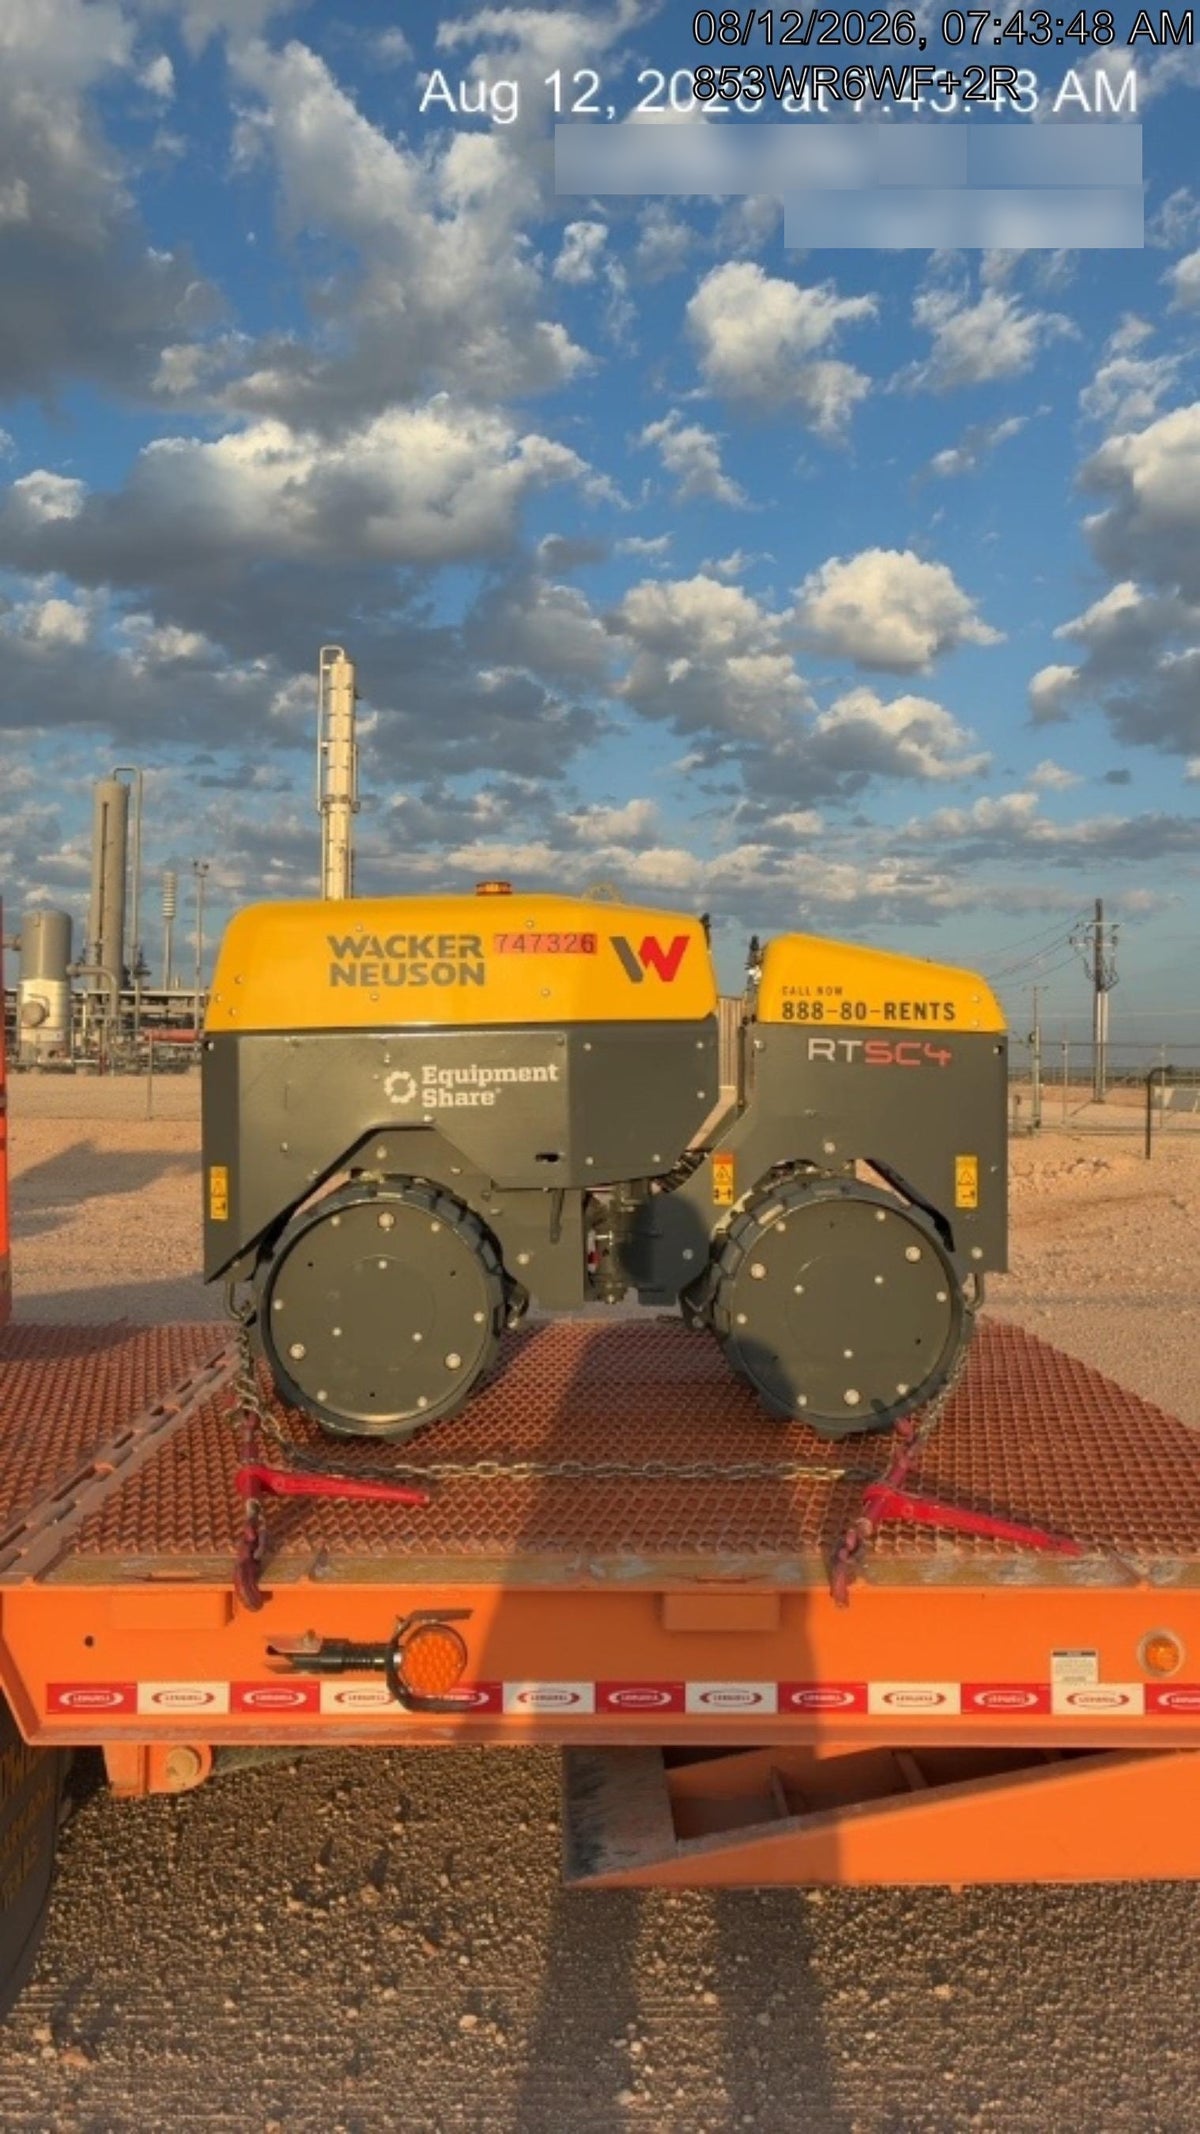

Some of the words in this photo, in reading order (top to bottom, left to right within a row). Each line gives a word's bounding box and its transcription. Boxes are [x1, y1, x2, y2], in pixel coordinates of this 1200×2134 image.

[326, 934, 486, 959] WACKER
[496, 933, 597, 954] 747326
[329, 962, 486, 987] NEUSON
[781, 1001, 956, 1021] 888-80-RENTS
[807, 1038, 952, 1067] RTSC4
[421, 1064, 560, 1089] Equipment
[421, 1087, 496, 1108] Share
